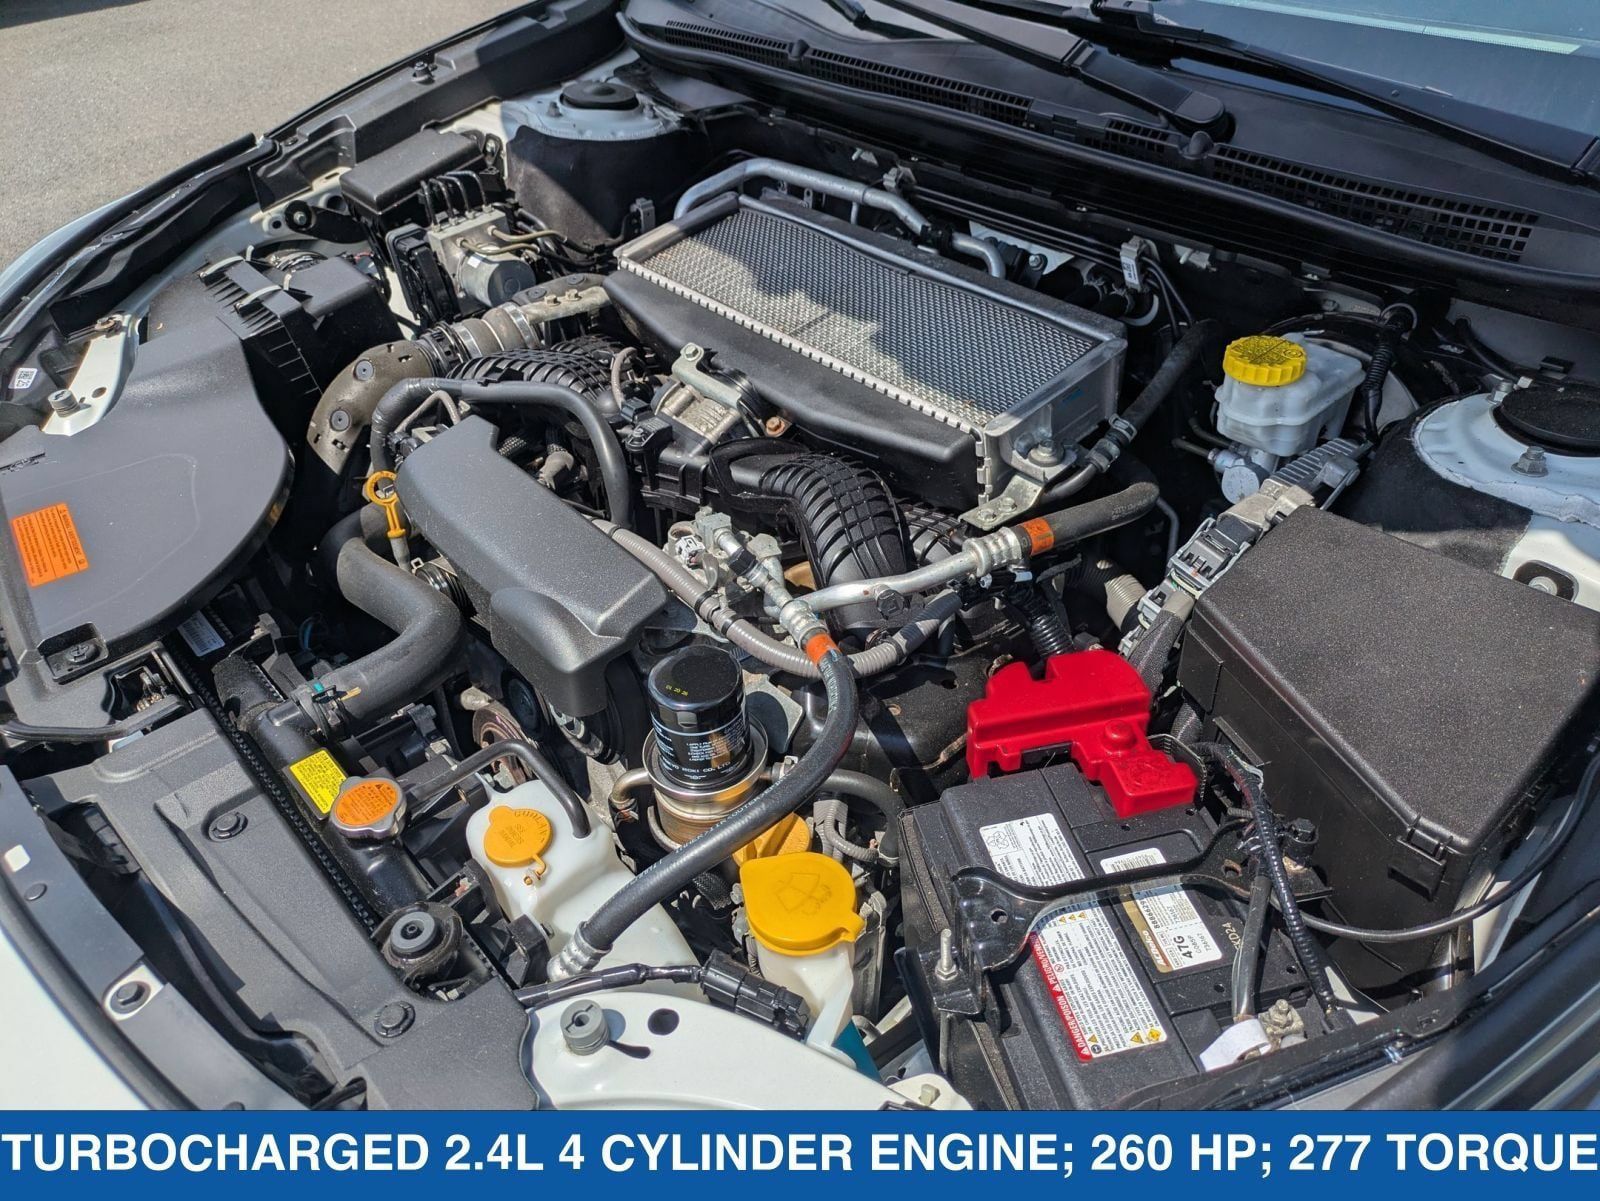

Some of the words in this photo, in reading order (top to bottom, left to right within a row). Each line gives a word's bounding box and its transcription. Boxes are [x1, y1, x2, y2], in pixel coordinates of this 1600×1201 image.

[1141, 930, 1167, 966] ACDelco
[1173, 935, 1193, 958] 47G
[1056, 994, 1085, 1048] DANGER/POISON
